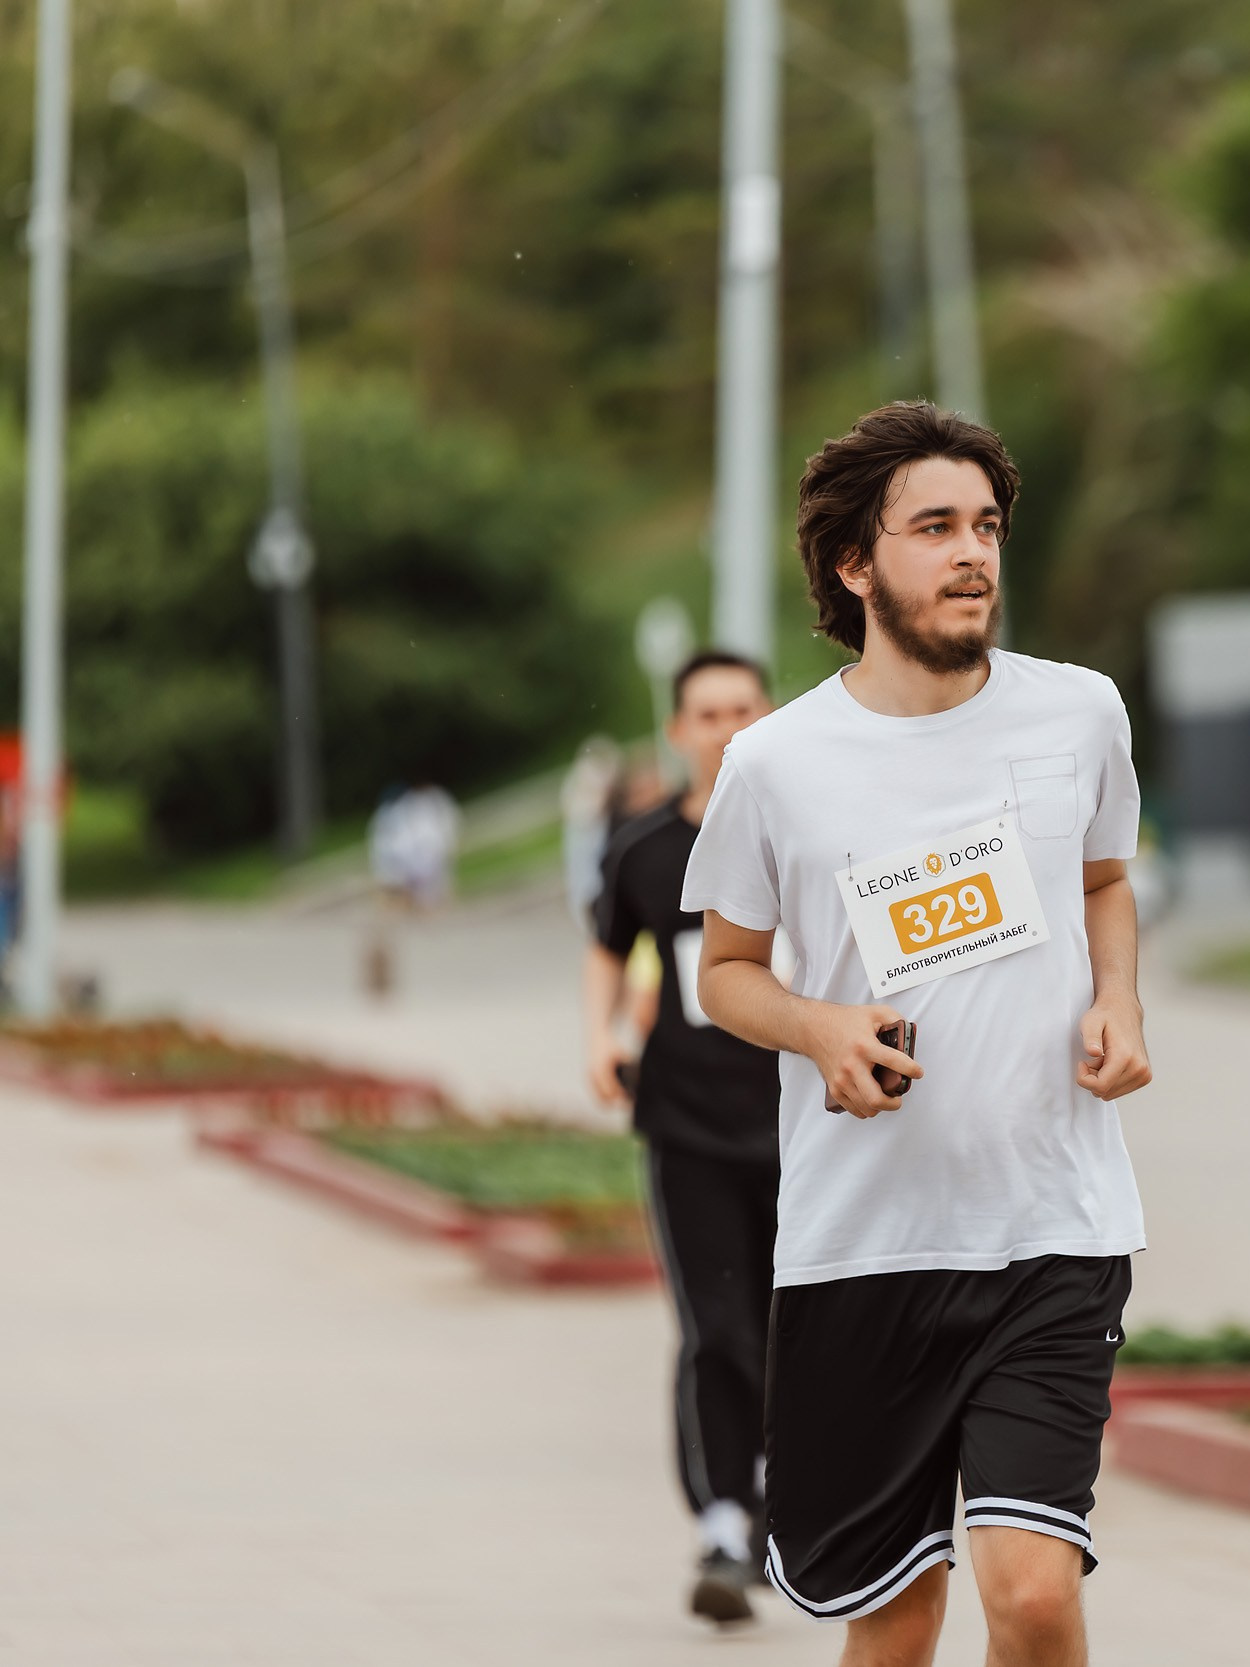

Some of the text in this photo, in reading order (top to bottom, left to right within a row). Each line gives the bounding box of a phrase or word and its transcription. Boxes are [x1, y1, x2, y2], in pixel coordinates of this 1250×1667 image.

[856, 837, 1004, 898] LEONE D'ORO
[903, 884, 988, 944] 329
[886, 923, 1028, 979] БЛАГОТВОРИТЕЛЬНЫЙ ЗАБЕГ
